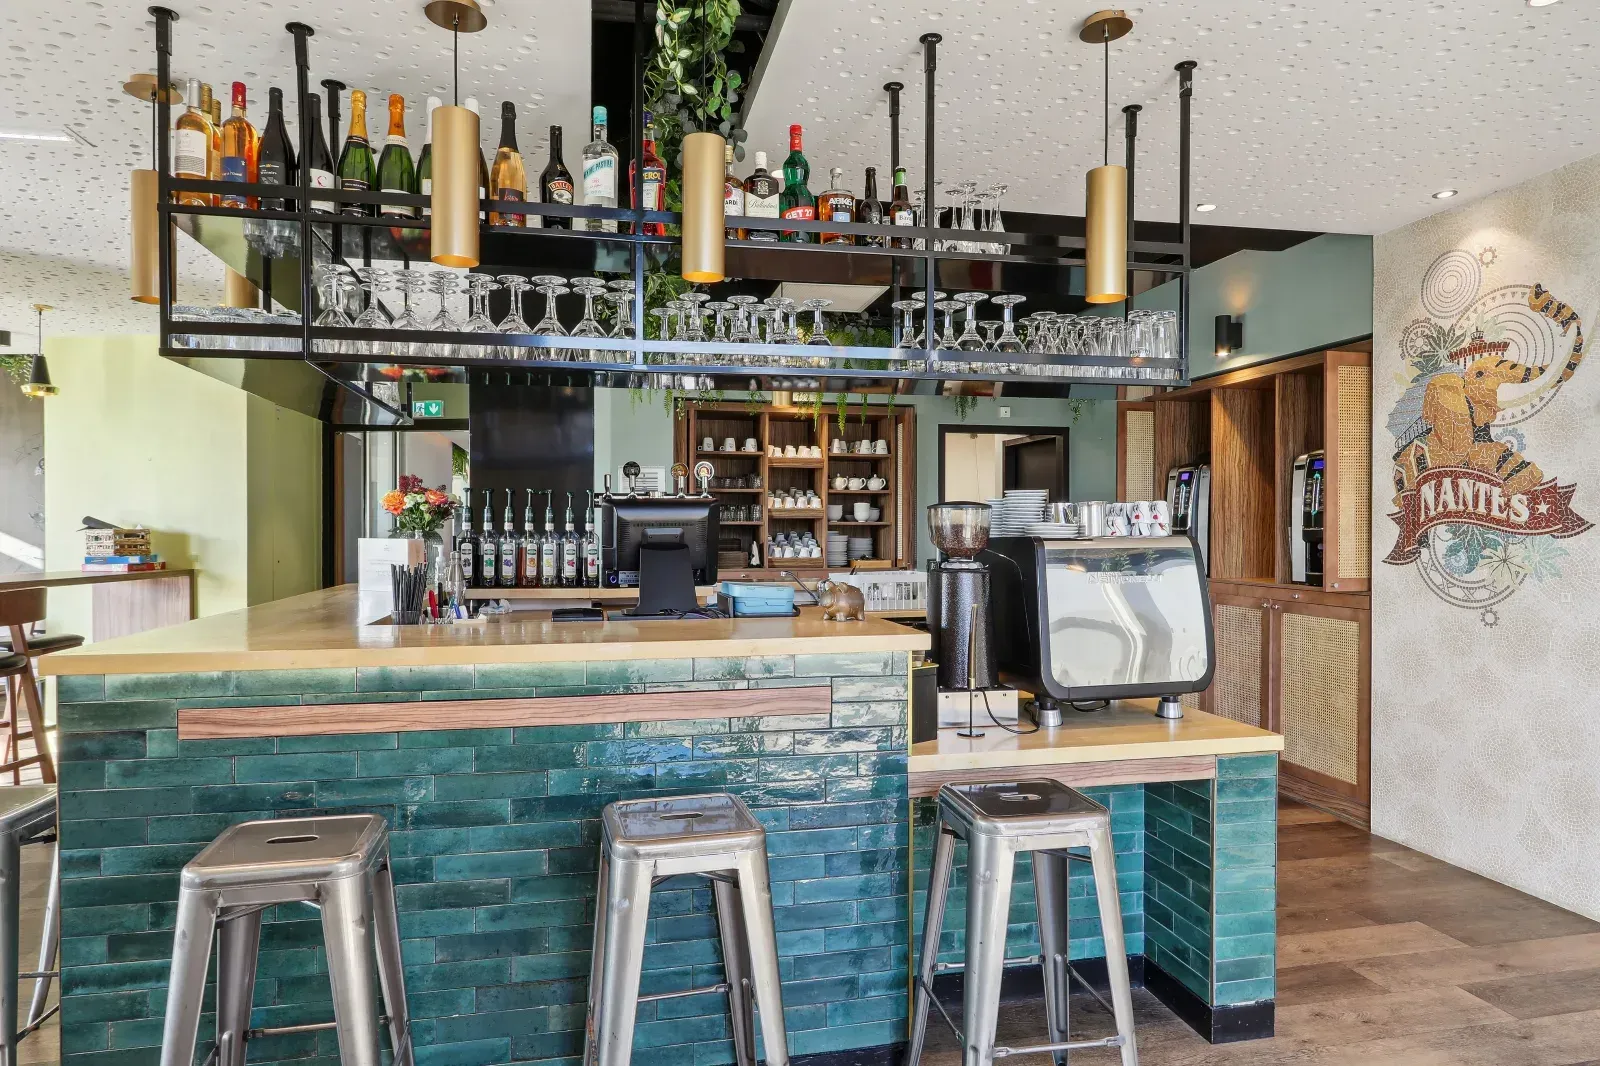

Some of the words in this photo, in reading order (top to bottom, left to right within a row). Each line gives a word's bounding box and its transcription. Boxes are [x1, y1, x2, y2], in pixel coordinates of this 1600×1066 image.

[643, 171, 661, 180] EROL
[786, 210, 803, 220] GET
[804, 208, 813, 217] 27
[1420, 477, 1530, 524] NANTES
